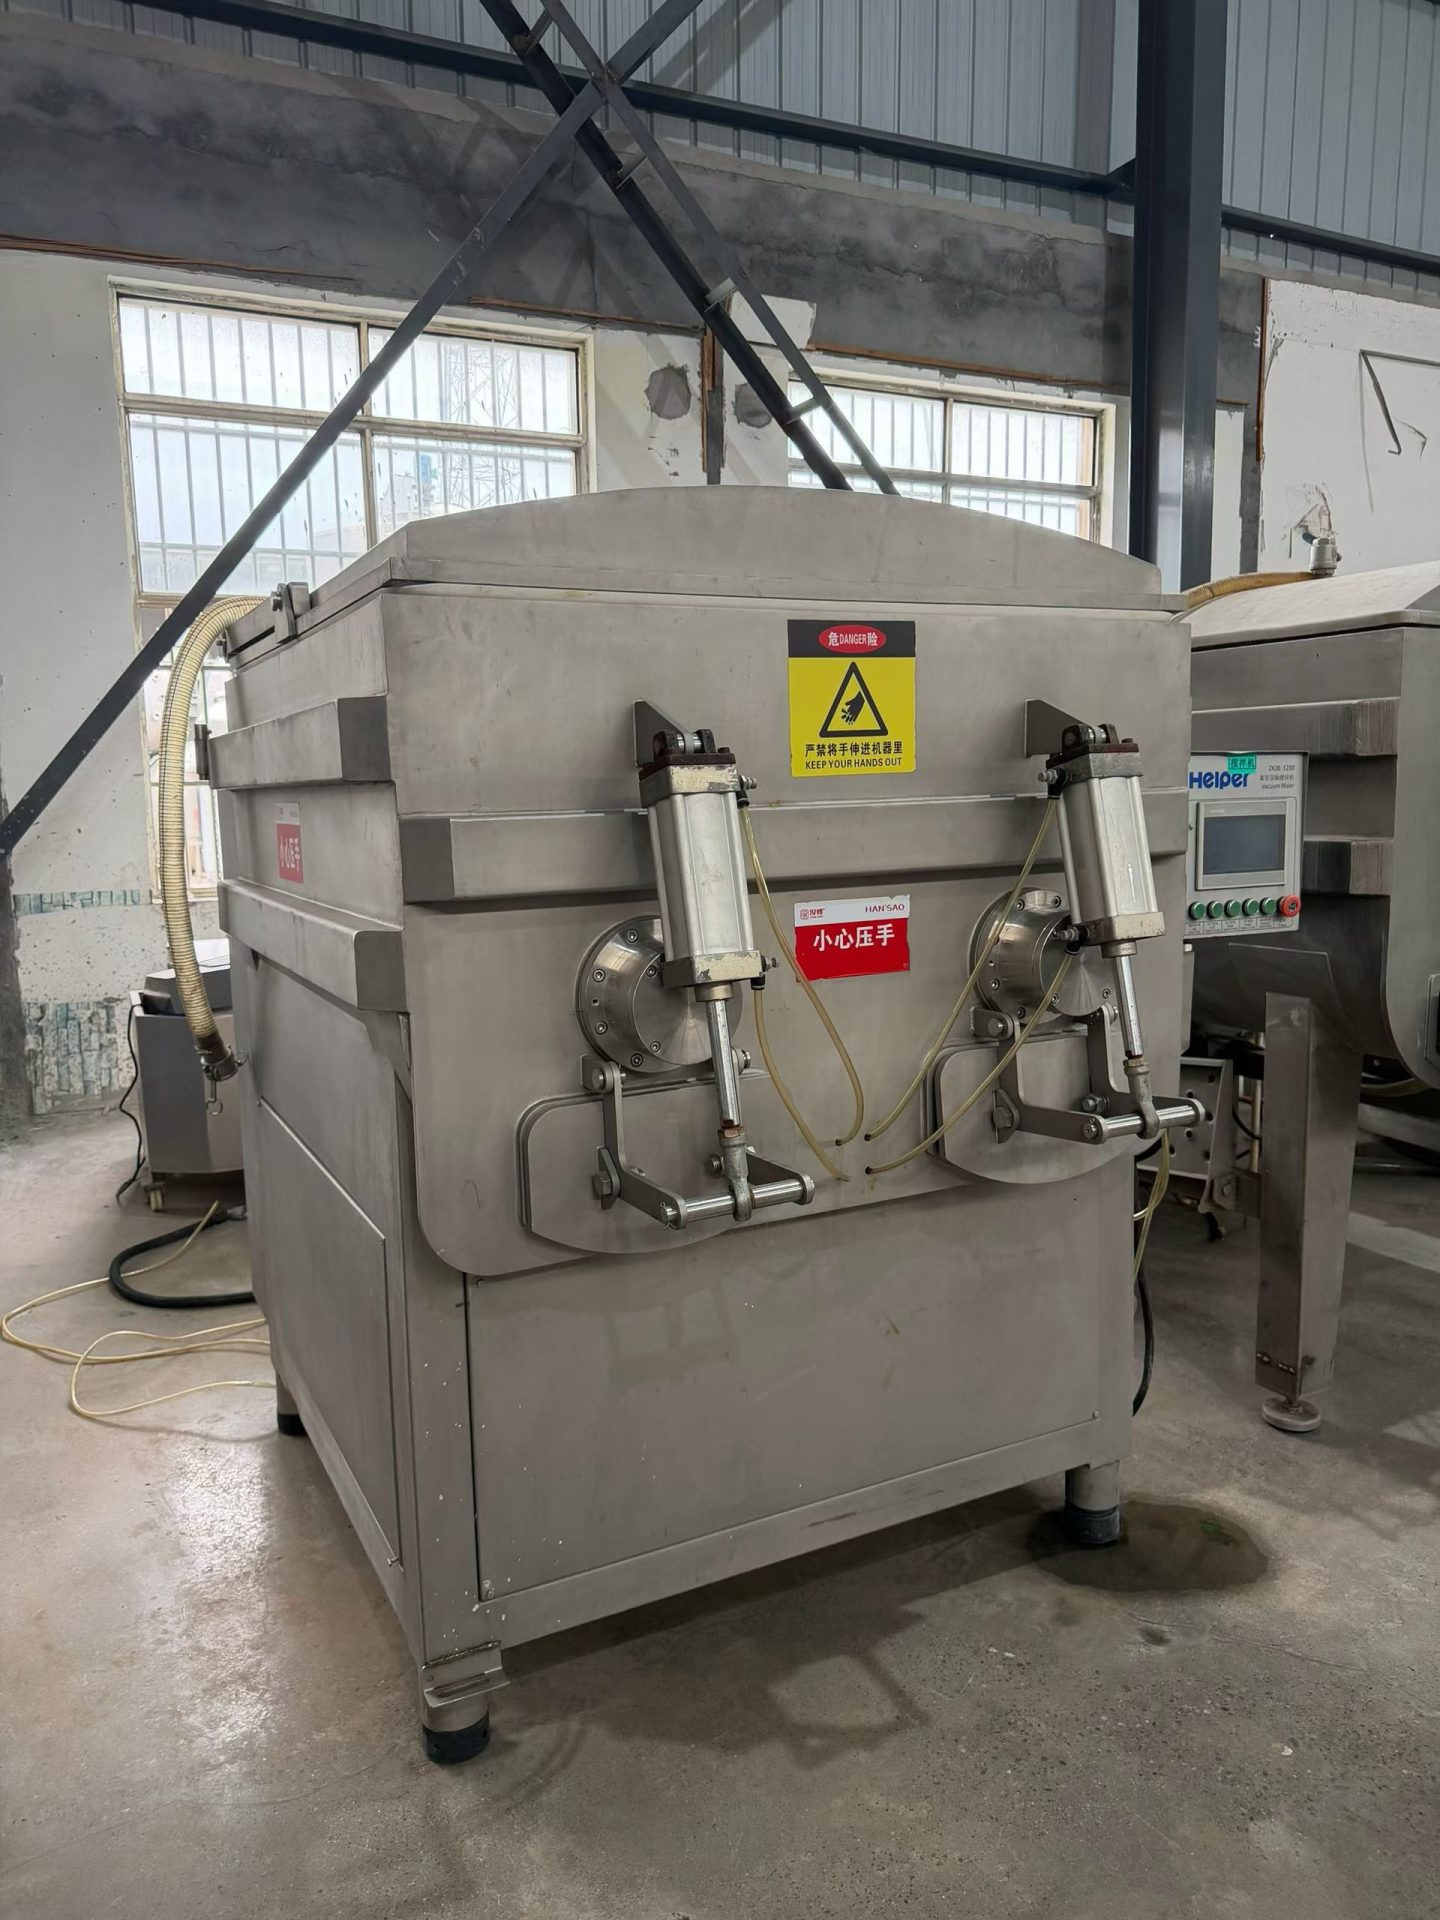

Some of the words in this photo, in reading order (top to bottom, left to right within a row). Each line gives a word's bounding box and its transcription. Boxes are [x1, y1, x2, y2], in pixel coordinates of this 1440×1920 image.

[805, 741, 903, 757] 严禁将手伸进机器里
[805, 760, 827, 770] KEEP
[828, 760, 853, 769] YOUR
[854, 758, 882, 768] HANDS
[884, 757, 903, 767] OUT
[1189, 771, 1250, 790] Helper
[865, 903, 905, 913] HAN'SAO
[813, 923, 895, 952] 小心压手
